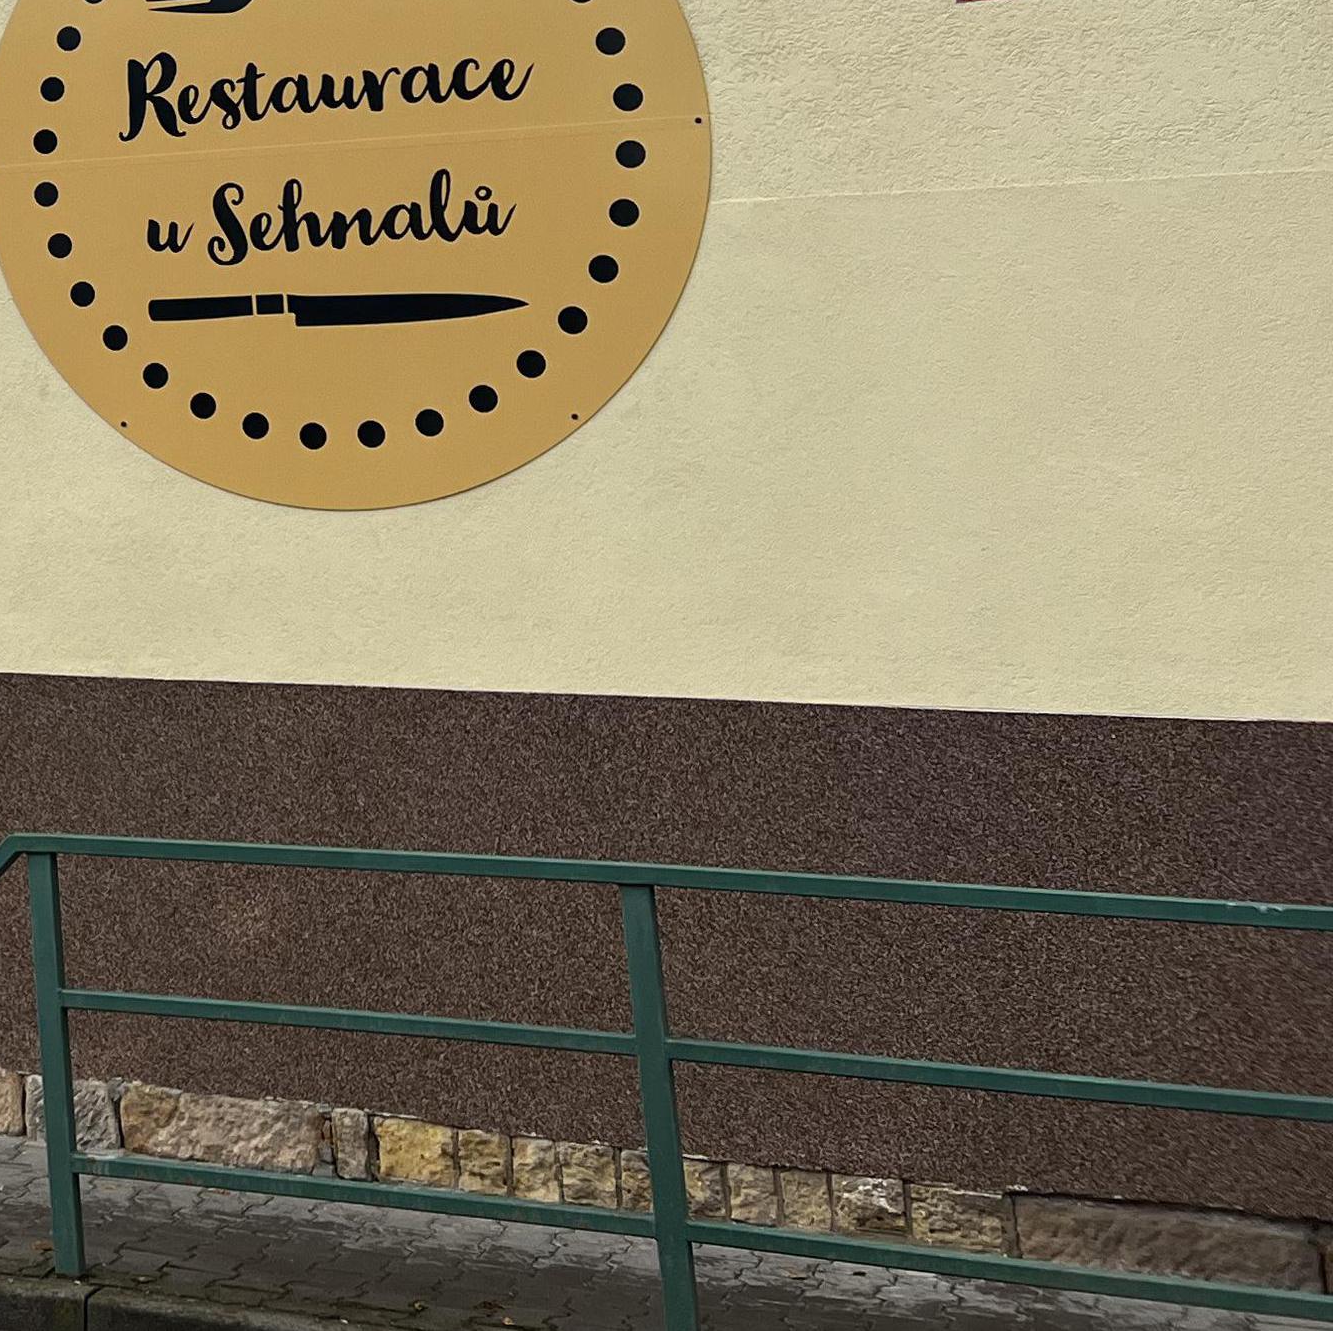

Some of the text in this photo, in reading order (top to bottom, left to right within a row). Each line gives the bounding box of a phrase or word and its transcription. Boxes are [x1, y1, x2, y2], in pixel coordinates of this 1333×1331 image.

[119, 51, 534, 142] Restaurace
[146, 168, 517, 266] u Sehnalů
